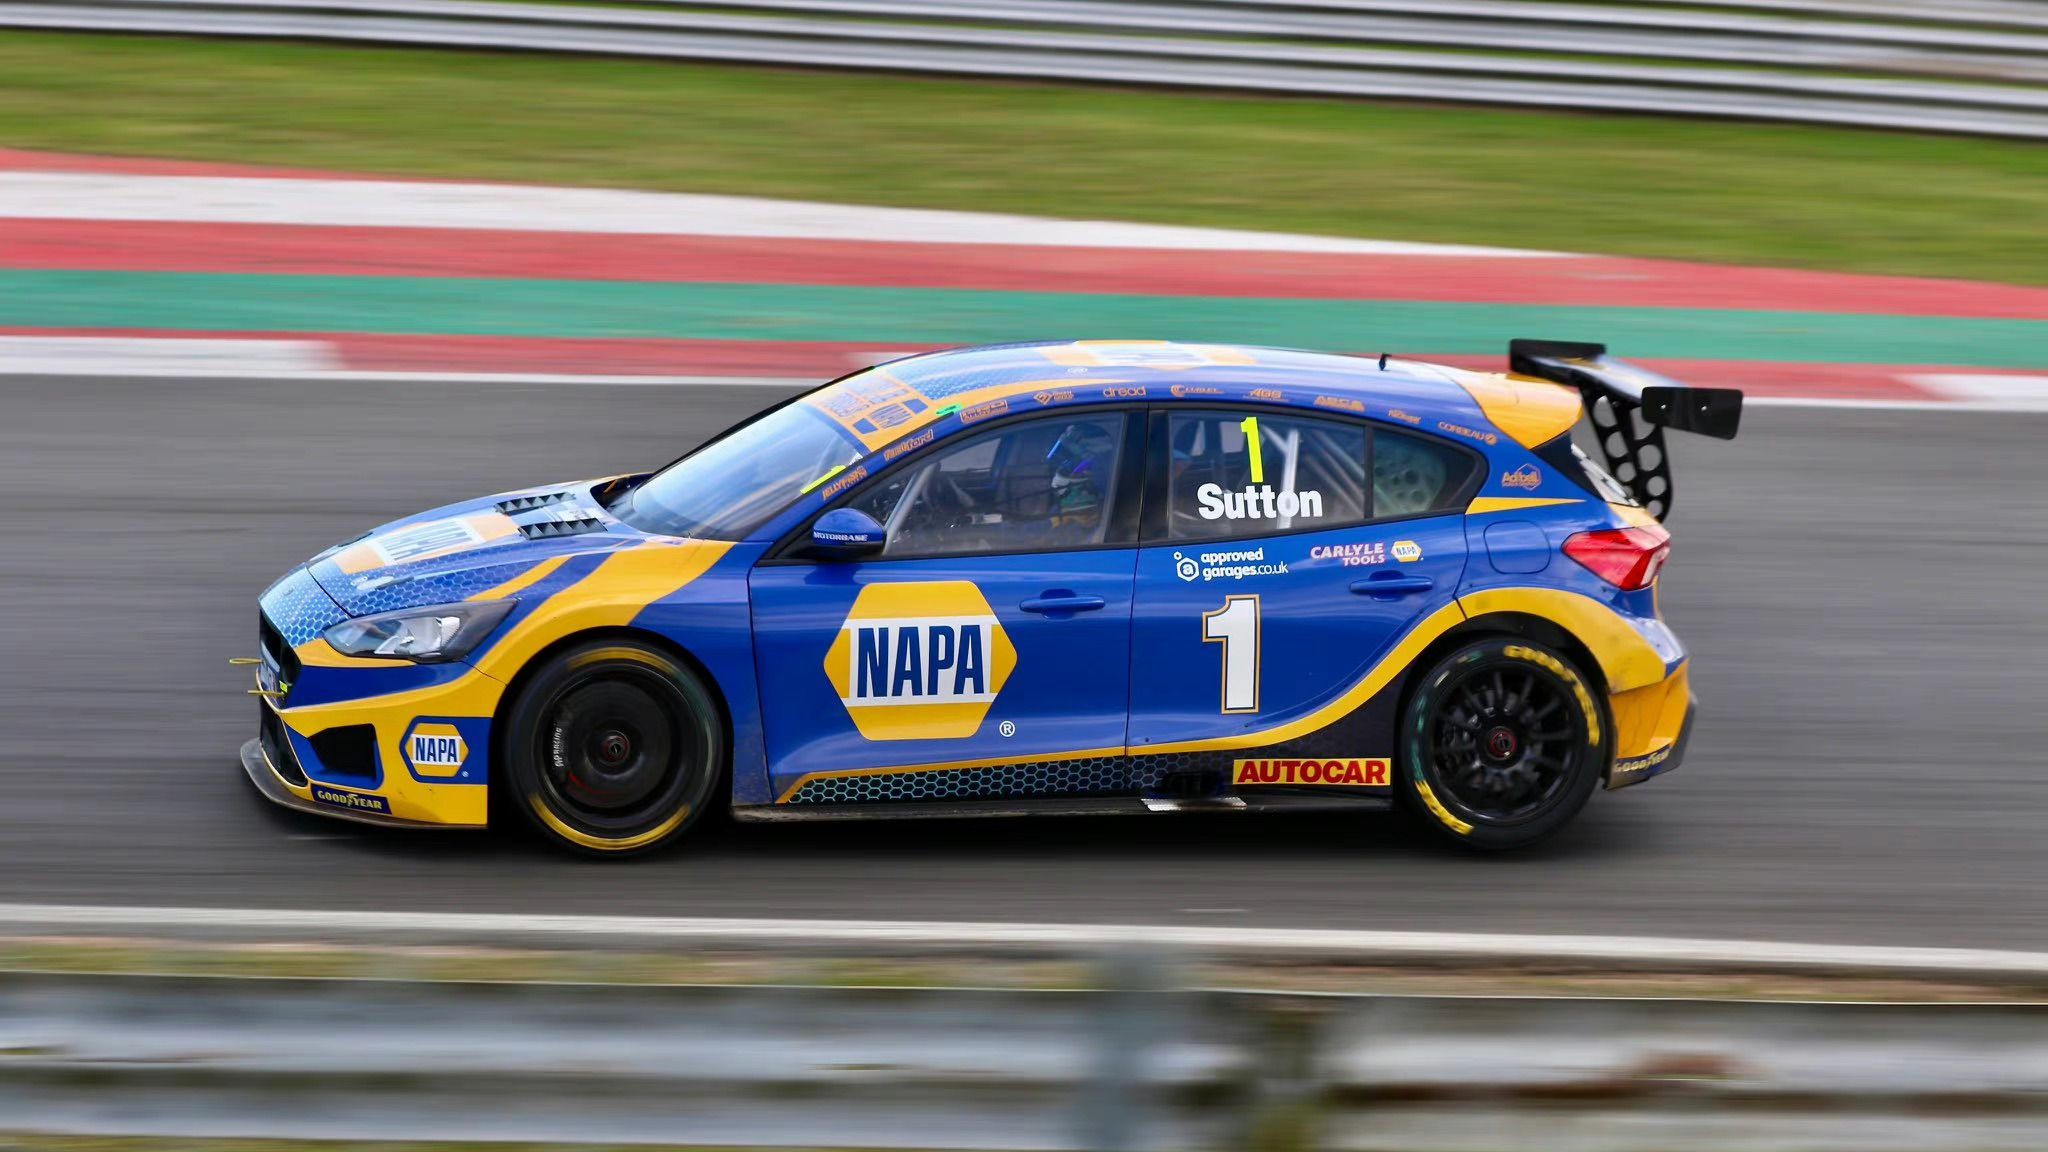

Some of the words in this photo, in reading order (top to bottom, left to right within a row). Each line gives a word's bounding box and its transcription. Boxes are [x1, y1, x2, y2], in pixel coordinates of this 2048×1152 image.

[1103, 385, 1146, 397] dread
[1240, 416, 1264, 483] 1
[1197, 482, 1323, 520] Sutton
[813, 530, 869, 542] MOTORBASE
[1200, 547, 1264, 566] approved
[1310, 542, 1385, 559] CARLYLE
[1343, 553, 1385, 567] TOOLS
[1395, 547, 1417, 556] NAPA
[1202, 560, 1289, 581] garages.co.uk
[857, 624, 985, 698] NAPA
[1202, 593, 1261, 715] 1
[415, 737, 459, 763] NAPA
[1237, 760, 1386, 784] AUTOCAR
[317, 789, 383, 810] GOODYEAR
